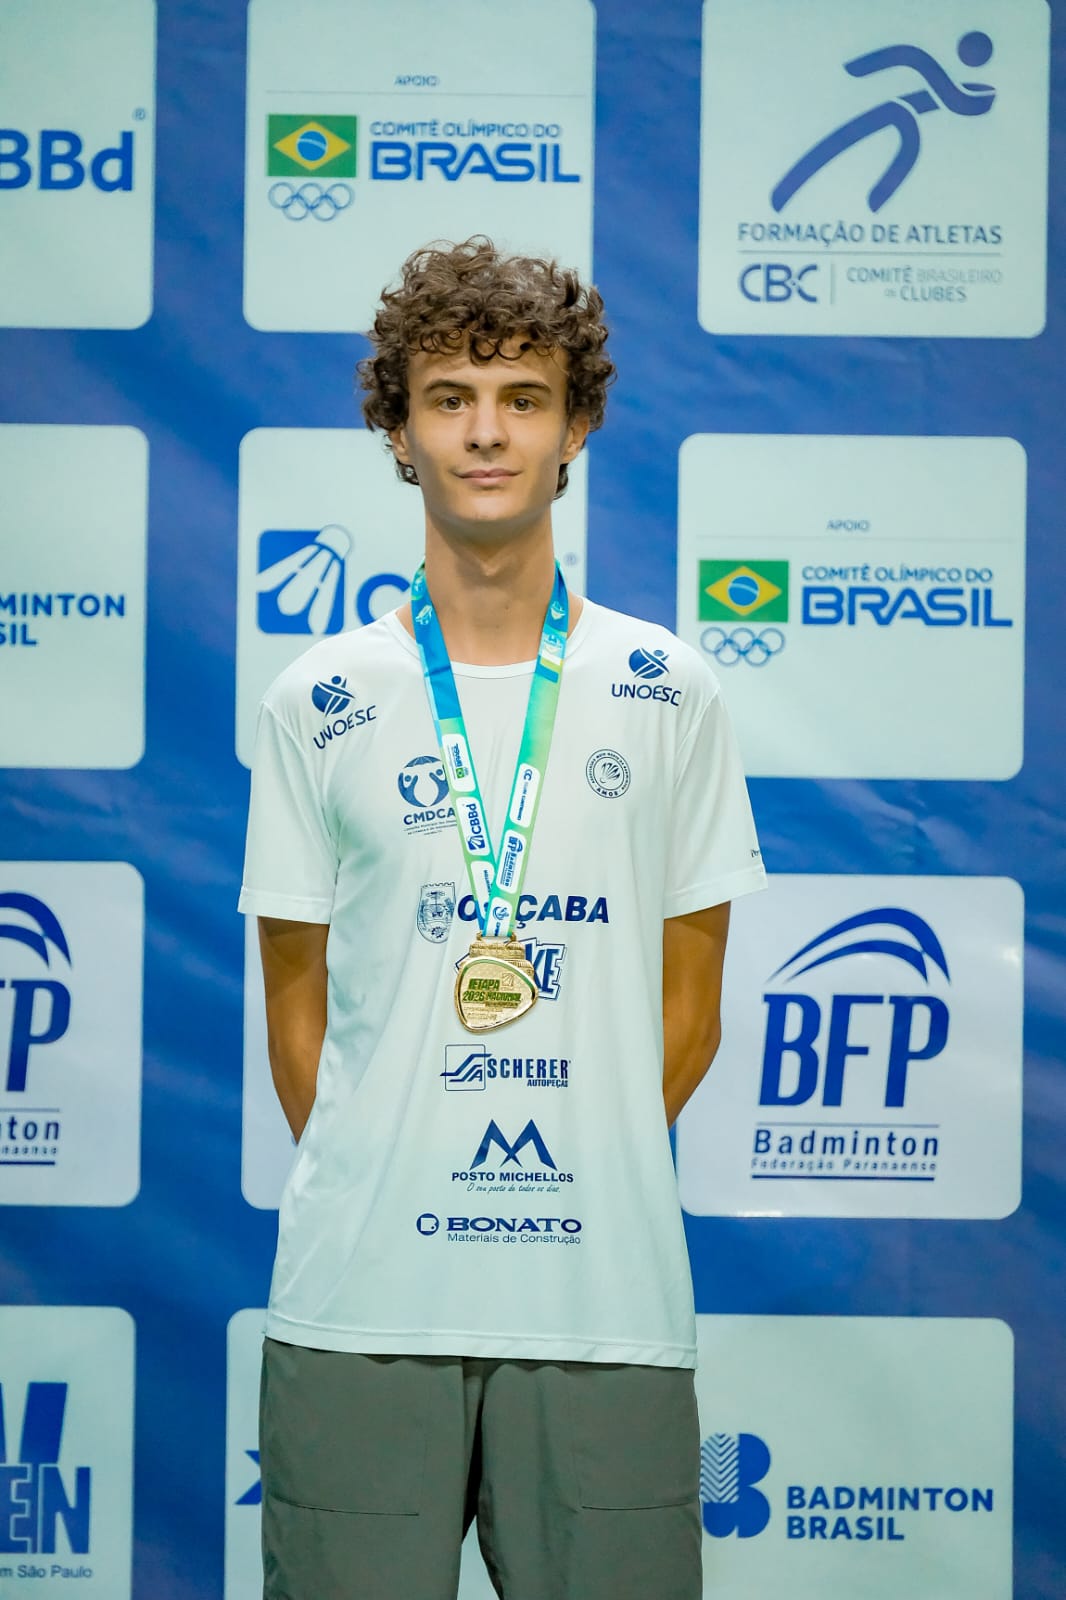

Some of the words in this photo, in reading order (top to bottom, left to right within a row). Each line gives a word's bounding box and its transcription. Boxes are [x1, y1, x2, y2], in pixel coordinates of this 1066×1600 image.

[394, 75, 439, 86] APOIO
[370, 119, 440, 137] COMITÊ
[442, 118, 529, 138] OLÍMPICO
[532, 123, 562, 138] DO
[369, 141, 581, 184] BRASIL
[737, 219, 866, 248] FORMAÇÃO
[871, 223, 900, 244] DE
[905, 224, 1003, 245] ATLETAS
[846, 266, 913, 284] COMITÊ
[915, 268, 1003, 285] BRASILEIRO
[899, 286, 968, 302] CLUBES
[826, 520, 870, 532] APOIO
[801, 564, 871, 582] COMITÊ
[874, 564, 962, 583] OLÍMPICO
[965, 568, 993, 583] DO
[801, 585, 1013, 627] BRASIL
[611, 682, 682, 707] UNOESC
[313, 704, 377, 750] UNOESC
[403, 807, 456, 825] CMDCA
[465, 803, 482, 835] CBBd
[457, 894, 610, 929] OÇABA
[758, 993, 950, 1107] BFP
[486, 1058, 569, 1079] SCHERER
[526, 1079, 569, 1088] AUTOPEÇAS
[753, 1129, 939, 1156] Badminton
[751, 1158, 834, 1173] Federação
[843, 1159, 936, 1172] Paranaense
[451, 1171, 495, 1182] POSTO
[499, 1171, 574, 1183] MICHELLOS
[466, 1183, 475, 1192] O
[487, 1185, 506, 1194] posto
[518, 1184, 536, 1192] todos
[446, 1216, 582, 1234] BONATO
[447, 1233, 499, 1243] Materiais
[502, 1234, 517, 1243] de
[520, 1234, 581, 1245] Construção
[786, 1486, 994, 1512] BADMINTON
[786, 1515, 905, 1541] BRASIL
[17, 1564, 47, 1578] São
[50, 1564, 93, 1578] Paulo
